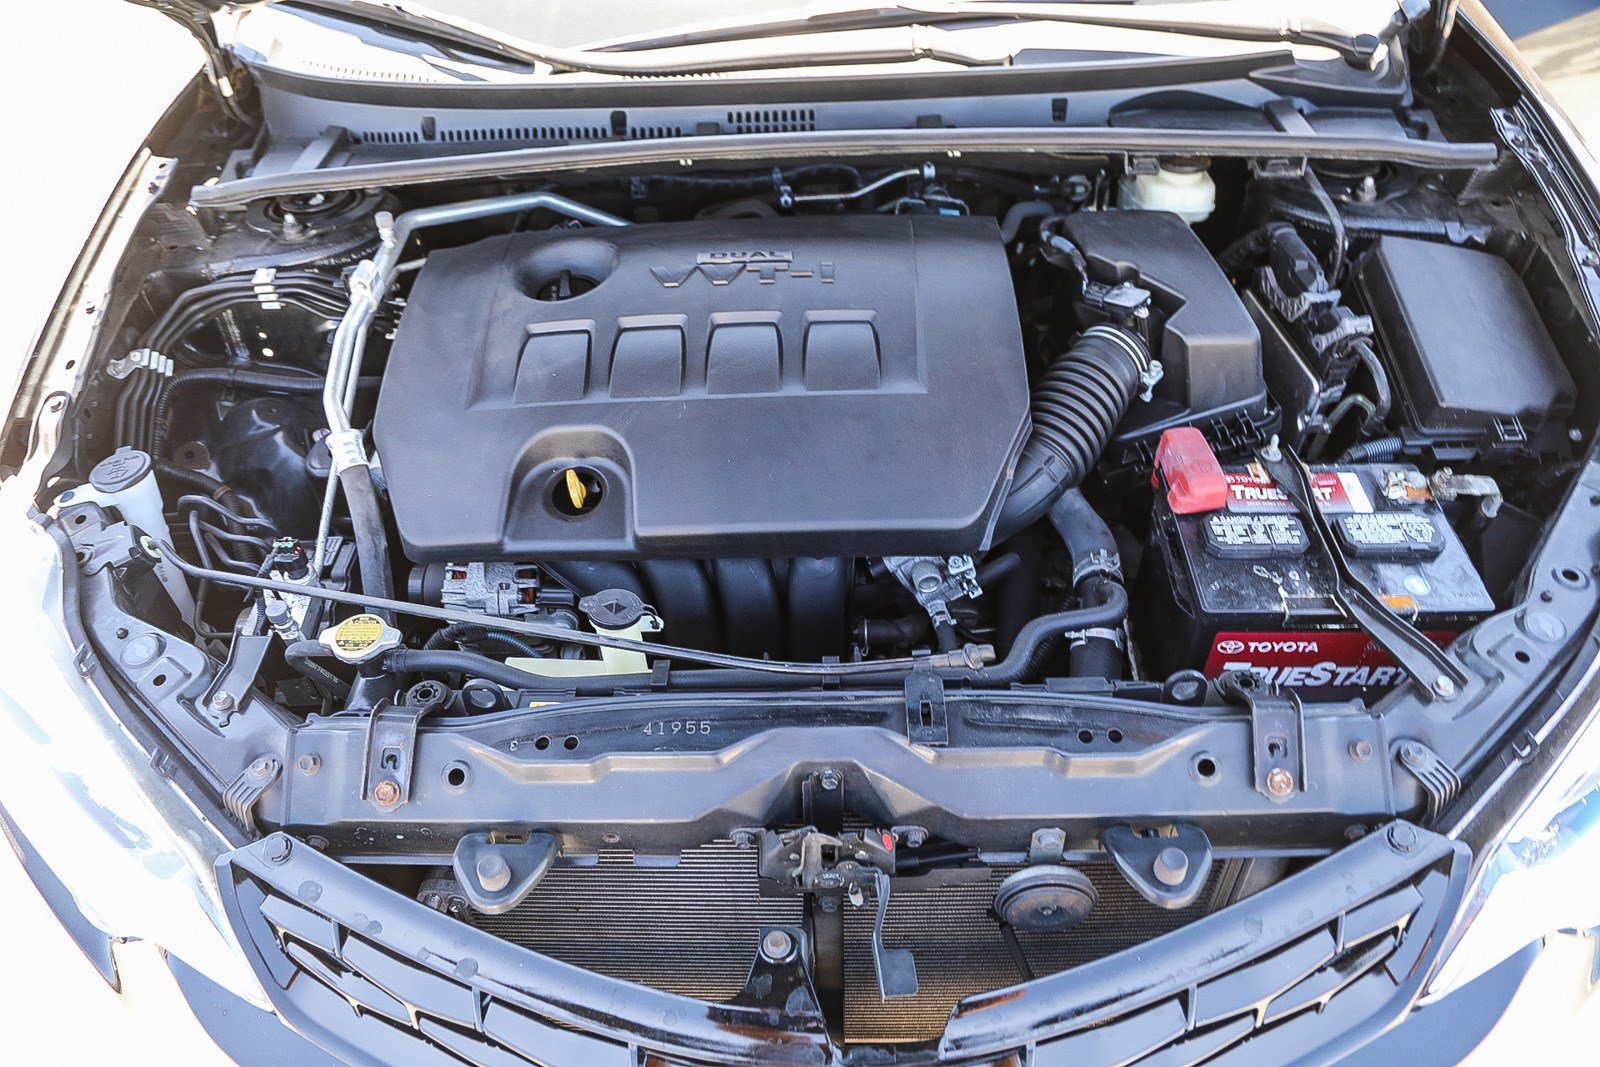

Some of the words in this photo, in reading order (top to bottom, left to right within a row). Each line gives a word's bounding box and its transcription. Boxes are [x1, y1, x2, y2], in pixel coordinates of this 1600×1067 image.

[710, 250, 786, 259] DUAL
[1248, 641, 1319, 653] TOYOTA
[643, 720, 712, 736] 41955
